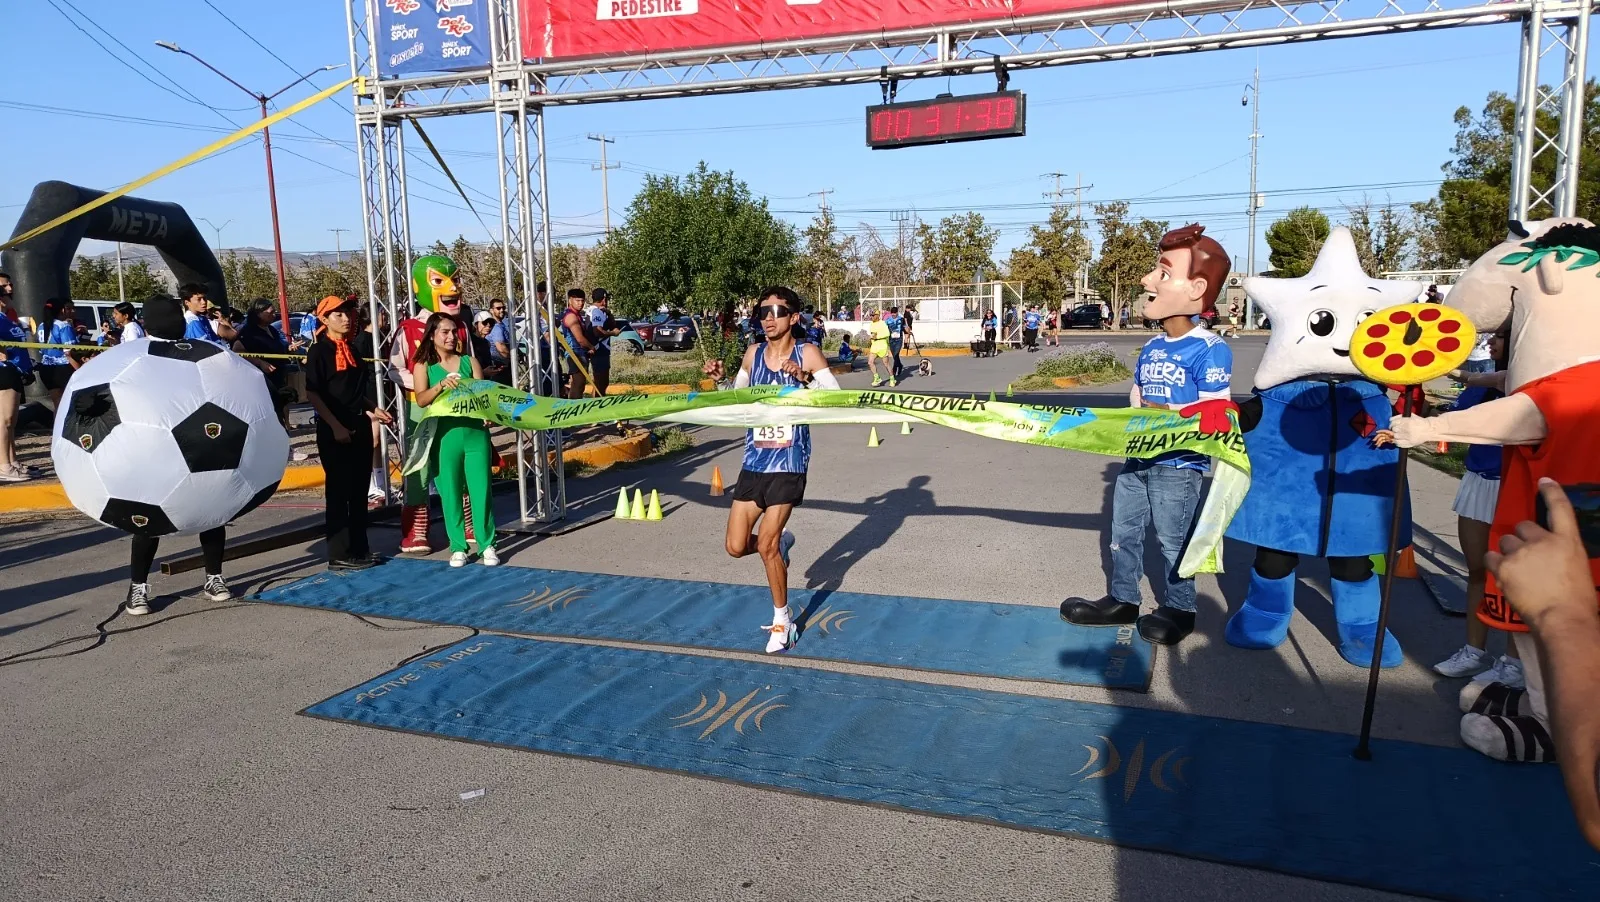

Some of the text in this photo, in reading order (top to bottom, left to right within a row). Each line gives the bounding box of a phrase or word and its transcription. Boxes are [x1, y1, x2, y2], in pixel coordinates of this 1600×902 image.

[611, 0, 682, 17] PEDESTRE
[390, 28, 418, 41] SPORT
[442, 46, 472, 58] SPORT
[108, 206, 168, 239] META
[498, 394, 533, 405] POWER
[858, 392, 987, 412] #HAYPOWER
[758, 425, 785, 439] 435
[1125, 430, 1248, 454] #HAYPOWE
